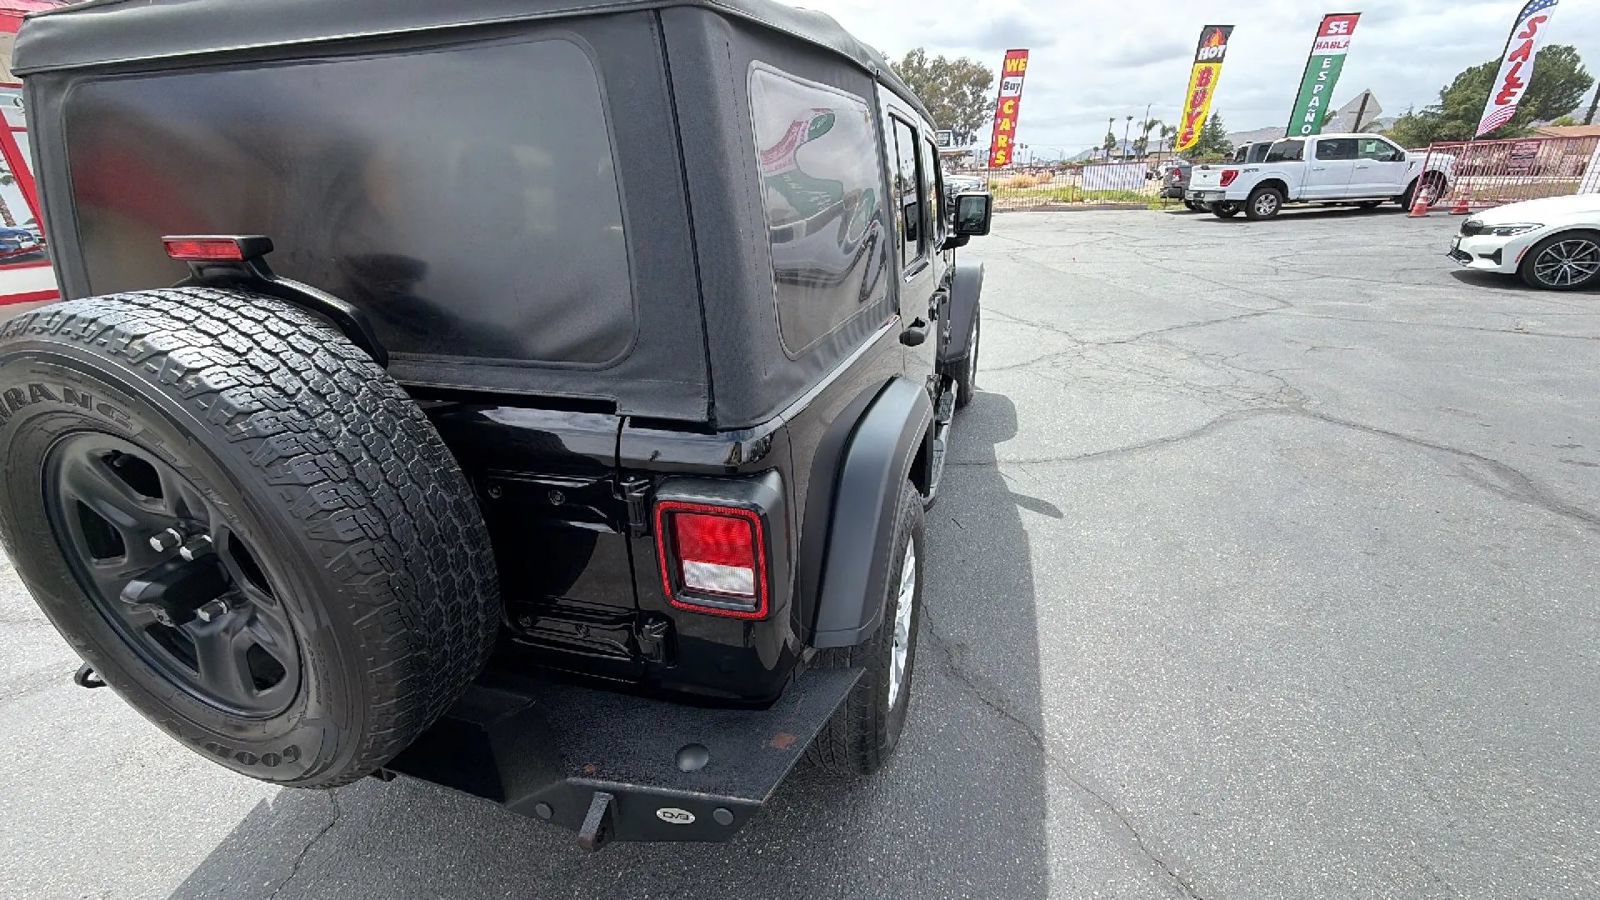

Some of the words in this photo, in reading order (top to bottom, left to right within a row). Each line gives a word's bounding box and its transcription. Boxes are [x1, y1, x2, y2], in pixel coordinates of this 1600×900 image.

[1327, 21, 1349, 34] SE
[1315, 40, 1350, 50] HABLA
[1198, 45, 1227, 61] HOT
[1006, 58, 1027, 72] WE
[1495, 15, 1548, 106] SALE
[1003, 81, 1020, 94] Buy
[995, 99, 1015, 165] CARS
